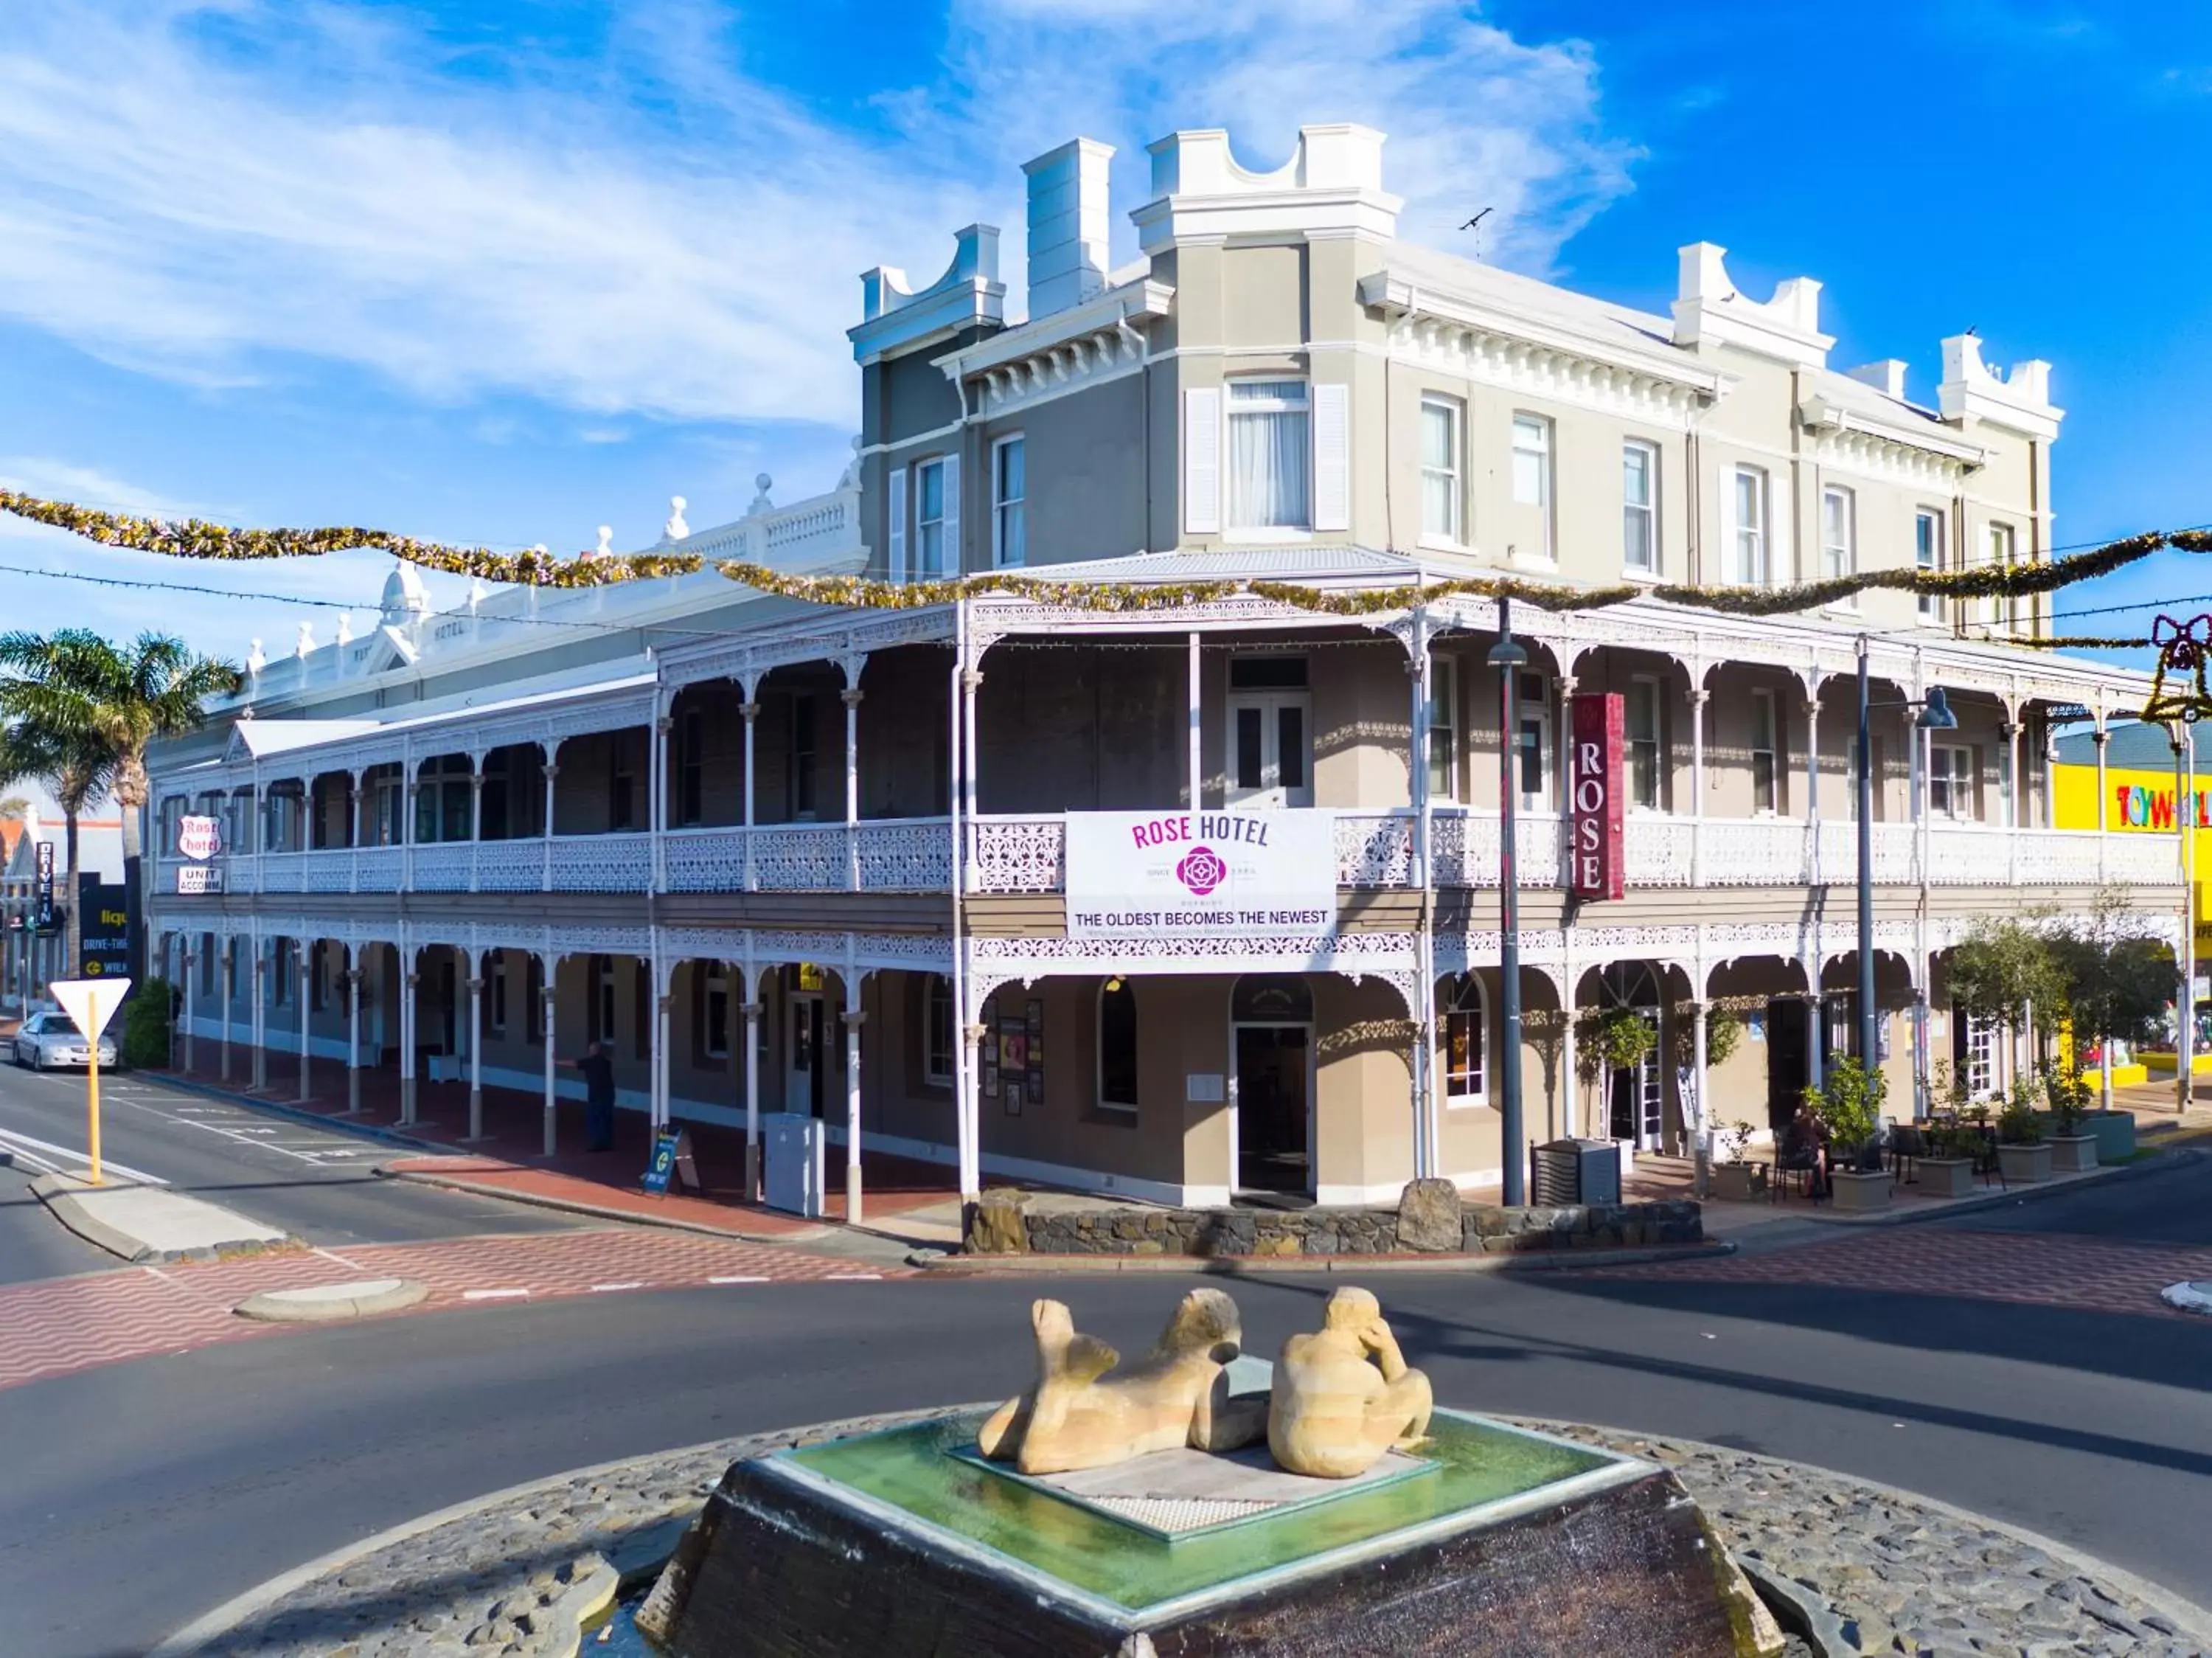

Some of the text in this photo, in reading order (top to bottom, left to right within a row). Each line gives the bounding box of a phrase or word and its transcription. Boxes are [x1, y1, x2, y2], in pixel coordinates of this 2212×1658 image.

[1577, 743, 1604, 888] ROSE
[1133, 816, 1268, 849] ROSE HOTEL
[186, 870, 217, 878] UNIT
[1076, 910, 1327, 926] THE OLDEST BECOMES THE NEWEST
